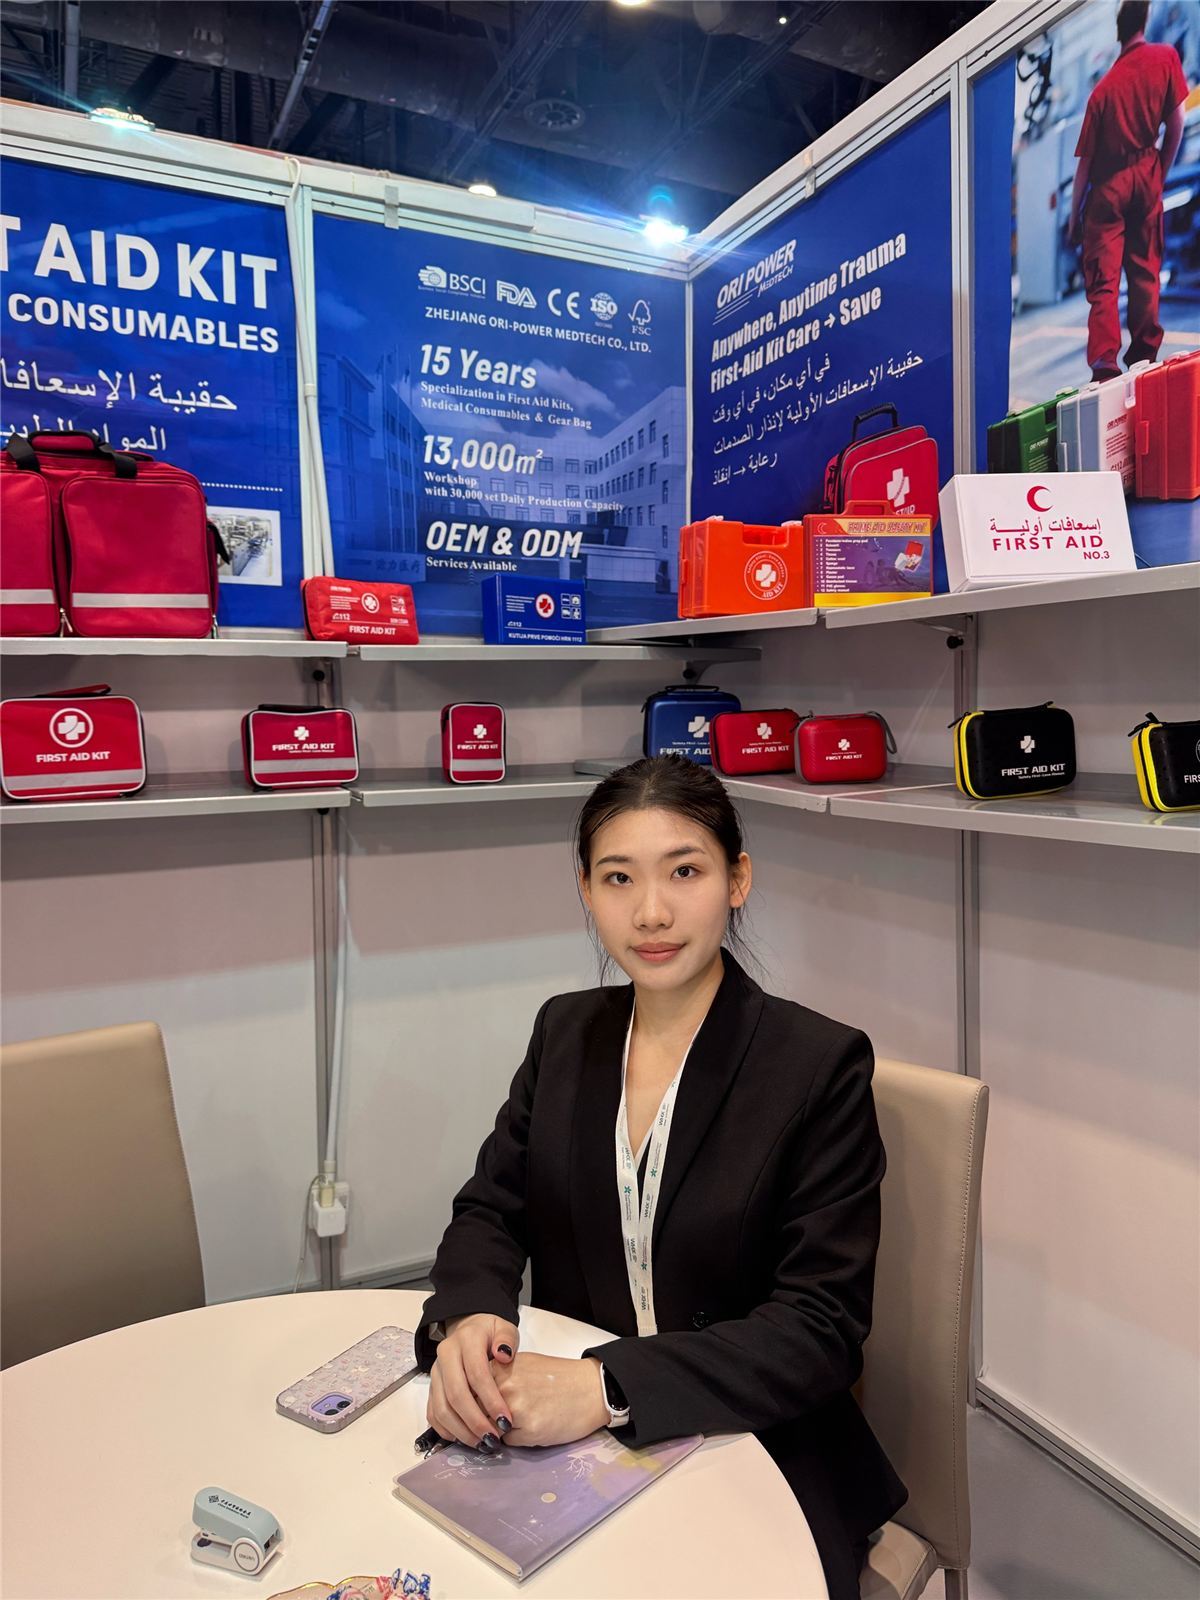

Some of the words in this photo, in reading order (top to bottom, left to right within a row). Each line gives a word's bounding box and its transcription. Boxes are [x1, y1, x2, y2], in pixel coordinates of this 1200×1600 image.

[34, 222, 160, 291] AID
[177, 242, 278, 310] KIT
[716, 269, 746, 309] ORI
[745, 239, 797, 292] POWER
[449, 273, 486, 295] BSCI
[496, 280, 538, 309] FDA
[711, 310, 777, 363] Anywhere,
[778, 273, 837, 326] Anytime
[839, 232, 906, 288] Trauma
[547, 288, 581, 320] CE
[590, 297, 618, 316] ISO
[8, 293, 279, 353] CONSUMABLES
[425, 306, 487, 327] ZHEJIANG
[488, 316, 553, 338] ORI-POWER
[554, 328, 606, 347] MEDTECH
[607, 336, 628, 352] CO.,
[629, 340, 652, 353] LTD.
[631, 325, 652, 336] FSC
[711, 346, 763, 394] First-Aid
[765, 336, 785, 365] Kit
[785, 319, 820, 354] Care
[839, 286, 882, 326] Save
[420, 343, 451, 376] 15
[459, 348, 537, 389] Years
[796, 357, 812, 390] أي
[814, 352, 831, 381] في
[886, 350, 924, 379] حقيبة
[0, 358, 137, 409] الإسعافا
[148, 372, 238, 415] حقيبة
[420, 380, 494, 400] Specialization
[496, 390, 506, 402] in
[507, 392, 531, 406] First
[532, 396, 550, 408] Aid
[551, 398, 574, 412] Kits,
[825, 363, 884, 405] الإسعافات
[421, 397, 463, 413] Medical
[465, 403, 530, 422] Consumables
[534, 412, 543, 422] &
[548, 413, 571, 426] Gear
[570, 417, 592, 430] Bag
[712, 403, 732, 424] وقت
[733, 395, 746, 421] أي
[747, 387, 761, 414] في
[786, 392, 823, 426] الأولية
[424, 471, 478, 488] Workshop
[424, 486, 448, 498] with
[484, 491, 500, 502] set
[500, 492, 526, 506] Daily
[527, 495, 582, 509] Production
[584, 498, 624, 513] Capacity
[425, 520, 489, 554] OEM
[492, 526, 514, 555] &
[521, 528, 583, 559] ODM
[1048, 517, 1102, 536] إسعافات
[992, 536, 1054, 551] FIRST
[1065, 535, 1104, 549] AID
[1083, 550, 1111, 560] NO.3
[425, 555, 469, 570] Services
[469, 560, 518, 572] Available
[349, 625, 369, 634] FIRST
[370, 626, 384, 635] AID
[384, 627, 396, 635] KIT
[35, 753, 68, 763] FIRST
[69, 752, 91, 761] AID
[92, 750, 111, 760] KIT
[272, 743, 300, 751] FIRST
[1001, 767, 1029, 777] FIRST
[1031, 765, 1048, 774] AID
[1049, 763, 1066, 772] KIT
